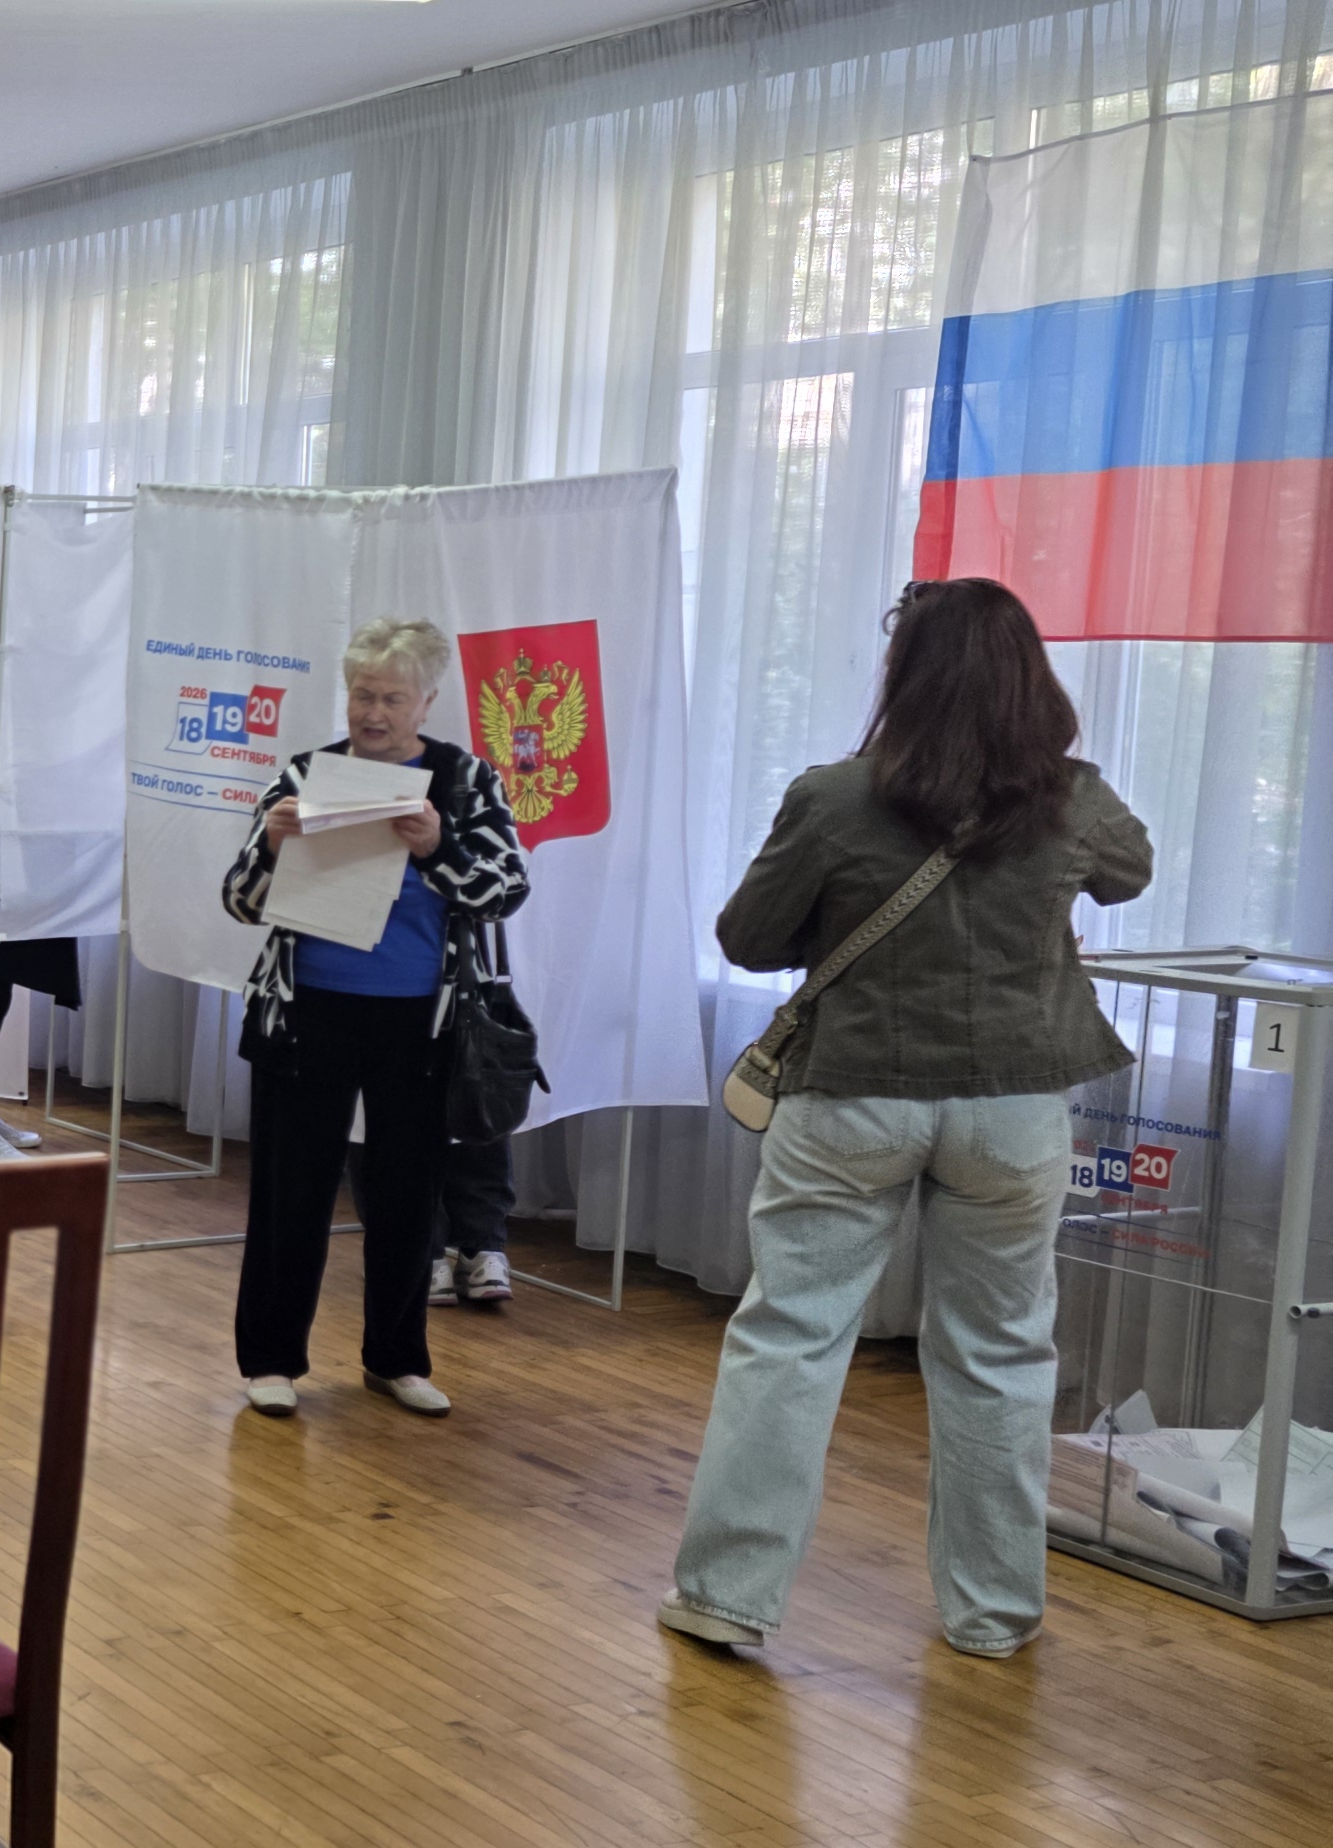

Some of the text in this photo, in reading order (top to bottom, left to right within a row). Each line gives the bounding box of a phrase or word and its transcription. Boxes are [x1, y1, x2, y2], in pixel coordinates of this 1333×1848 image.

[146, 639, 311, 674] ЕДИНЫЙ ДЕНЬ ГОЛОСОВАНИЯ
[179, 686, 208, 700] 2026
[178, 696, 276, 743] 18 19 20
[210, 745, 276, 767] СЕНТЯБРЯ
[131, 772, 159, 789] ТВОЙ
[160, 779, 204, 797] ГОЛОС
[1267, 1023, 1285, 1053] 1
[1084, 1107, 1117, 1122] ДЕНЬ
[1120, 1114, 1221, 1141] ГОЛОСОВАНИЯ
[1070, 1153, 1168, 1188] 18 19 20
[1062, 1218, 1098, 1234] ОЛОС
